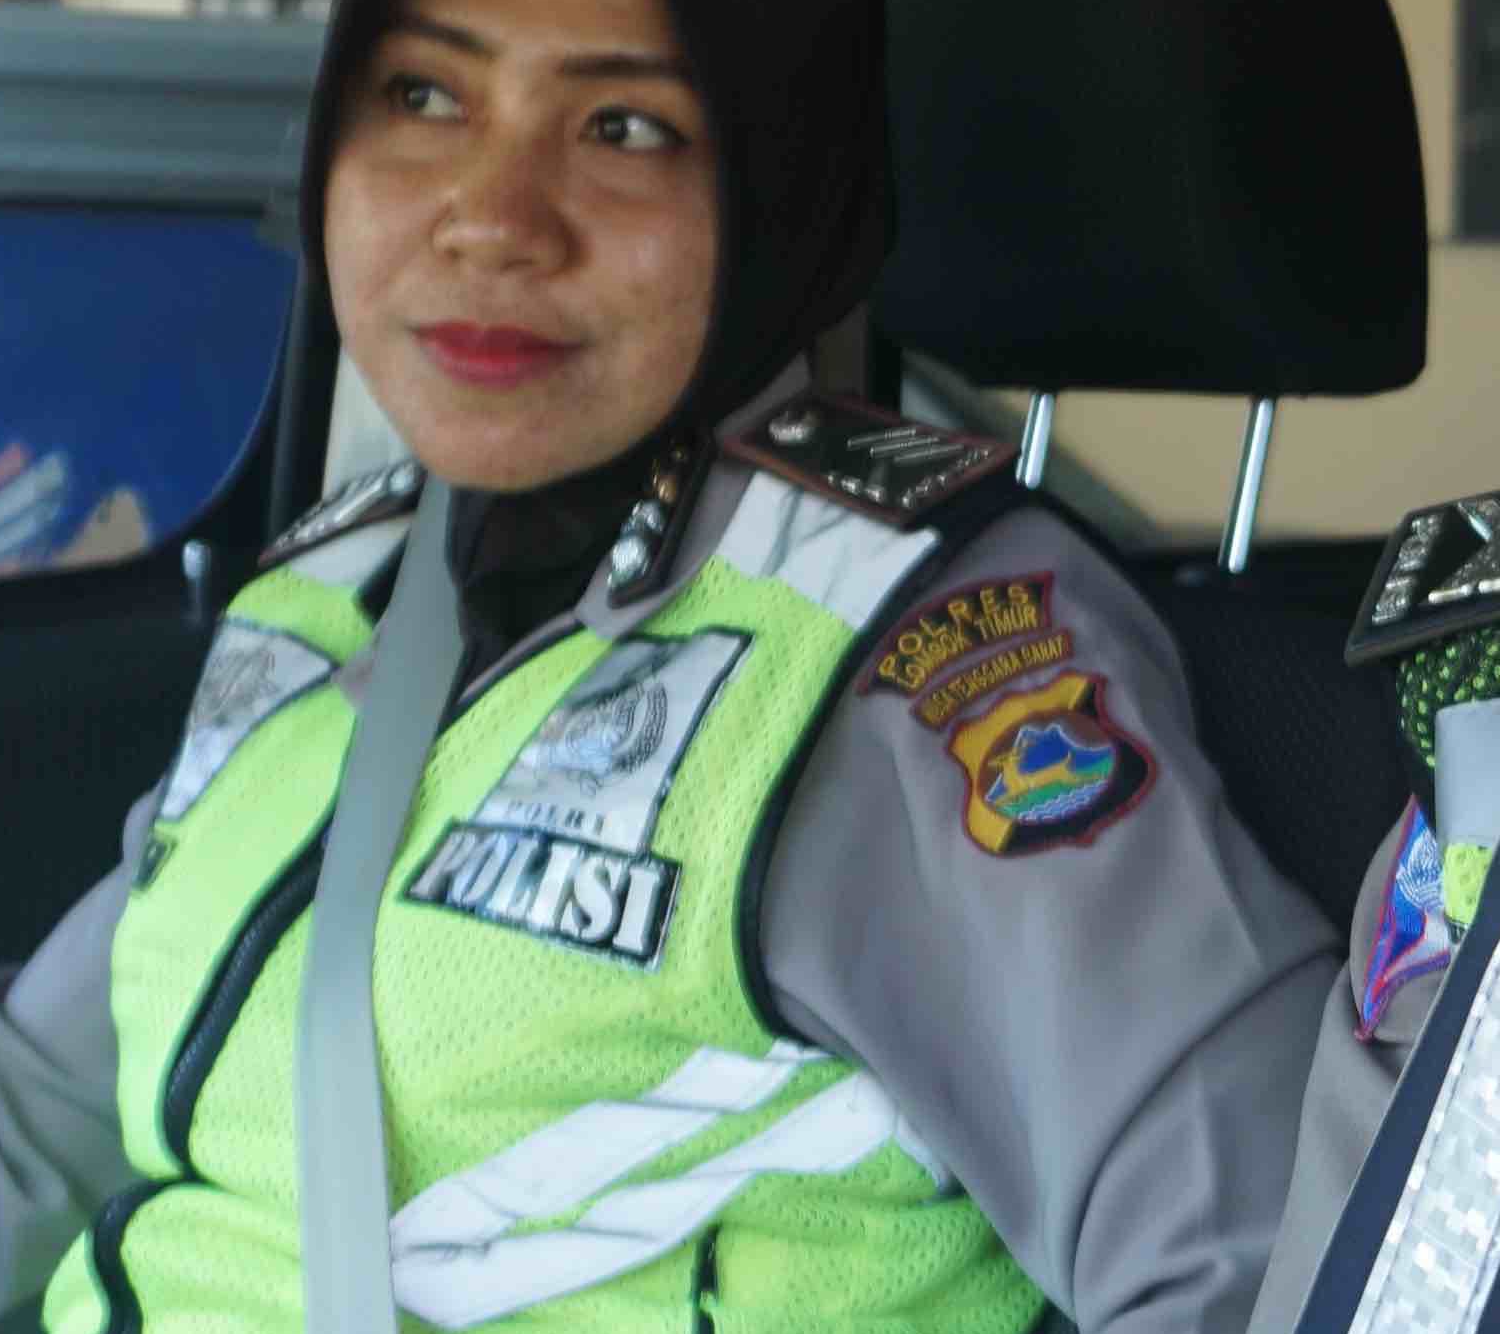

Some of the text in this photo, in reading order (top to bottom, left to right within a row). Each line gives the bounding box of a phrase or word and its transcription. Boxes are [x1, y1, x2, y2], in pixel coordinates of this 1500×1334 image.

[878, 584, 1030, 685] POLRES
[975, 605, 1038, 645] TIMUR
[409, 830, 661, 954] POLISI
